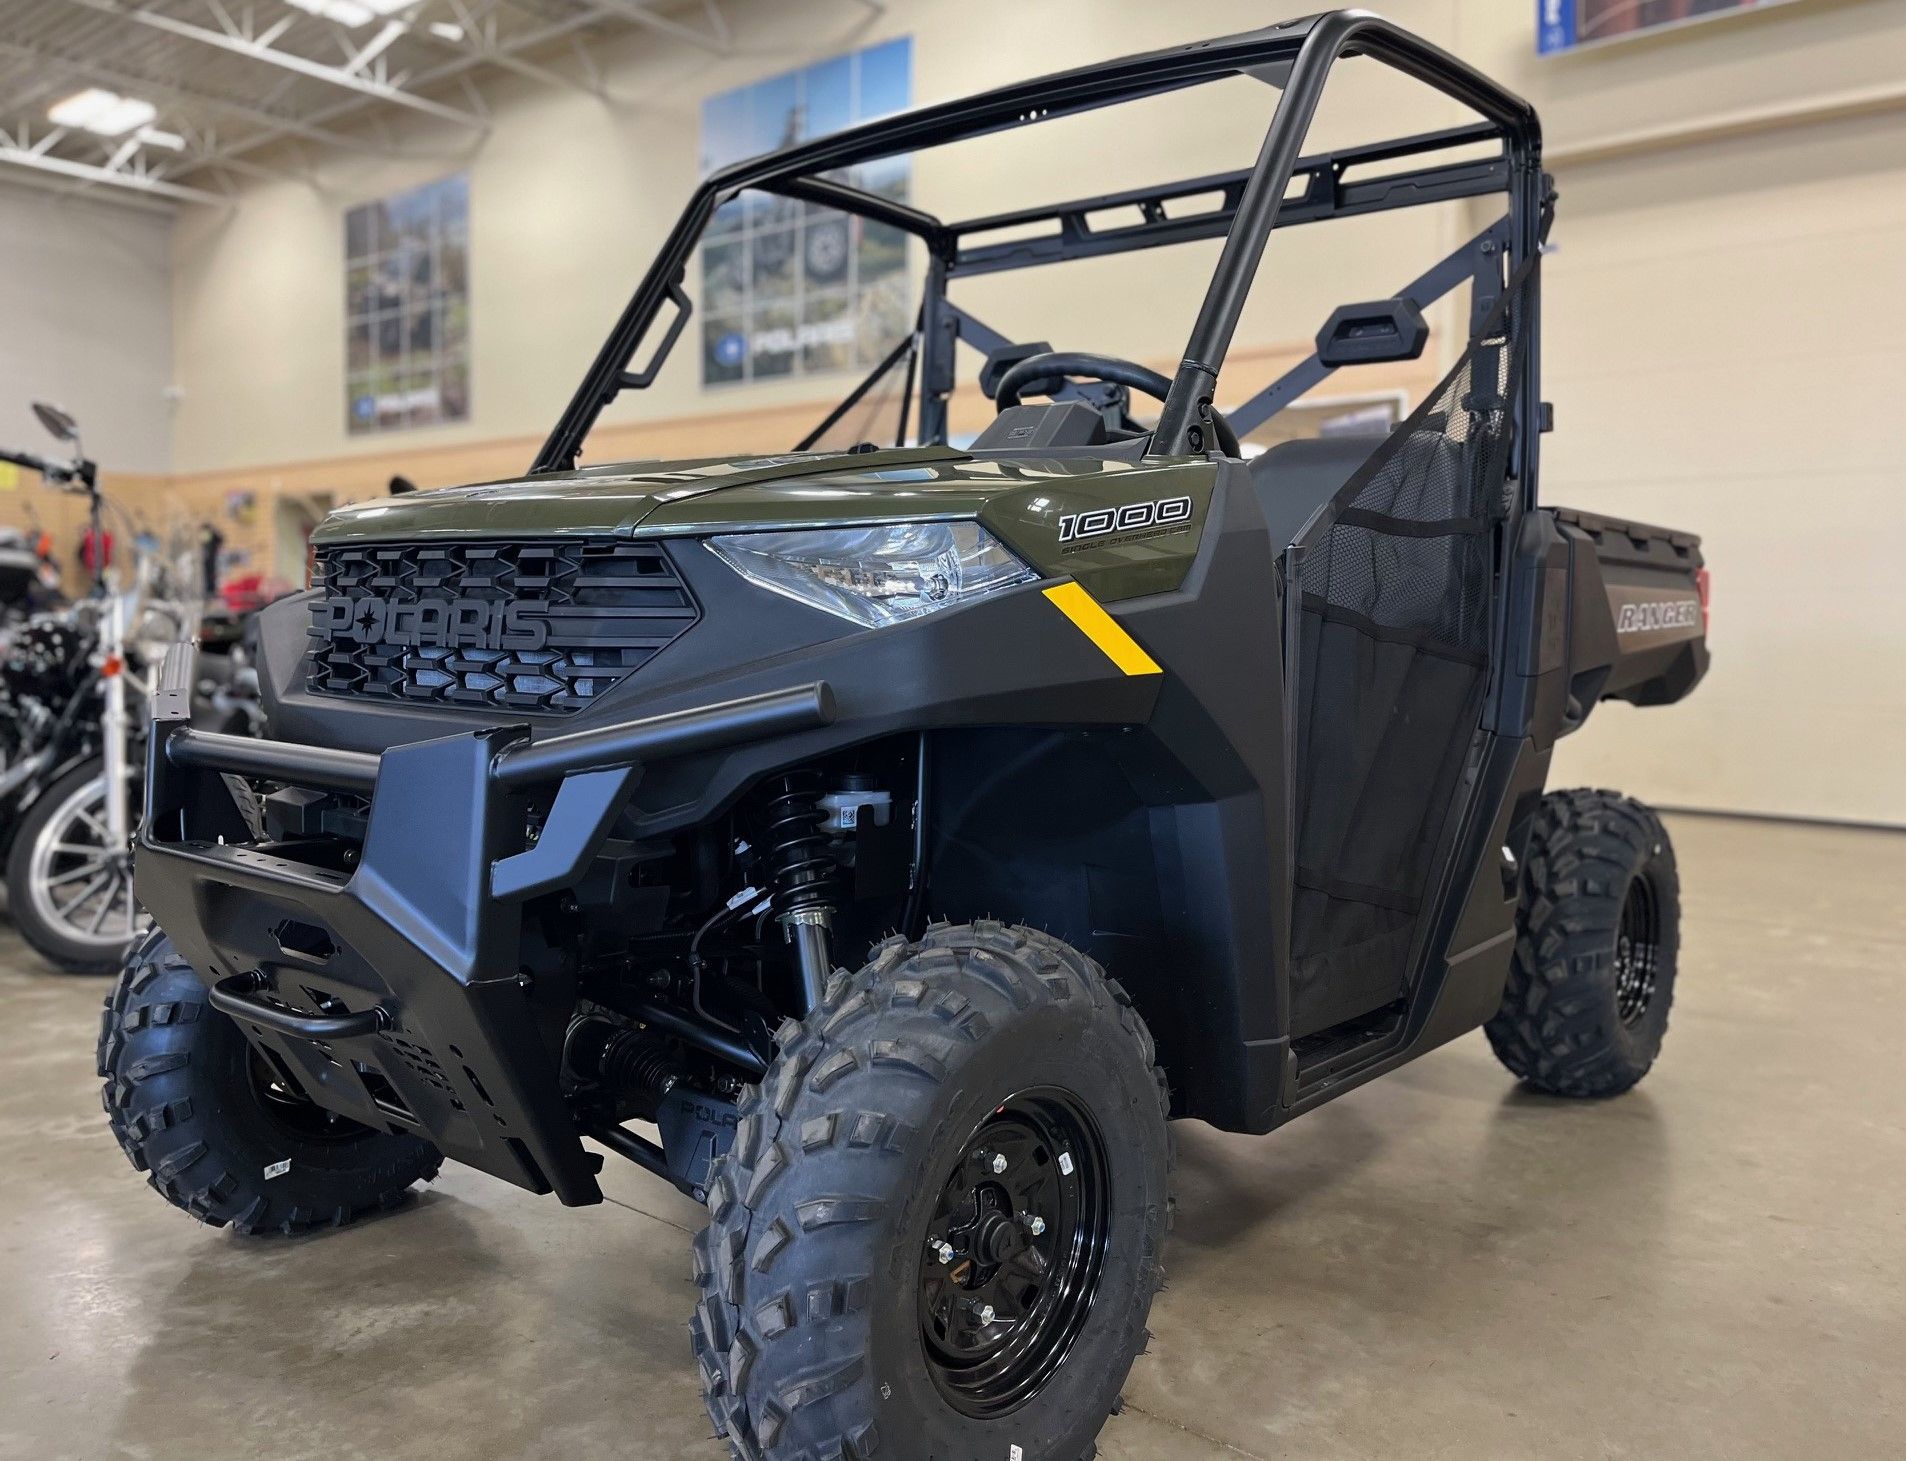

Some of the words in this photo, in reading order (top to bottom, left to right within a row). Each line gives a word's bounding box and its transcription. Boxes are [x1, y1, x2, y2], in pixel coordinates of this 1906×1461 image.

[1059, 496, 1193, 542] 1000
[1061, 540, 1105, 555] SINGLE
[1109, 528, 1167, 545] OVERHEAD
[1169, 524, 1192, 534] CAM
[323, 597, 548, 650] POLARIS
[1616, 600, 1697, 633] RANGER
